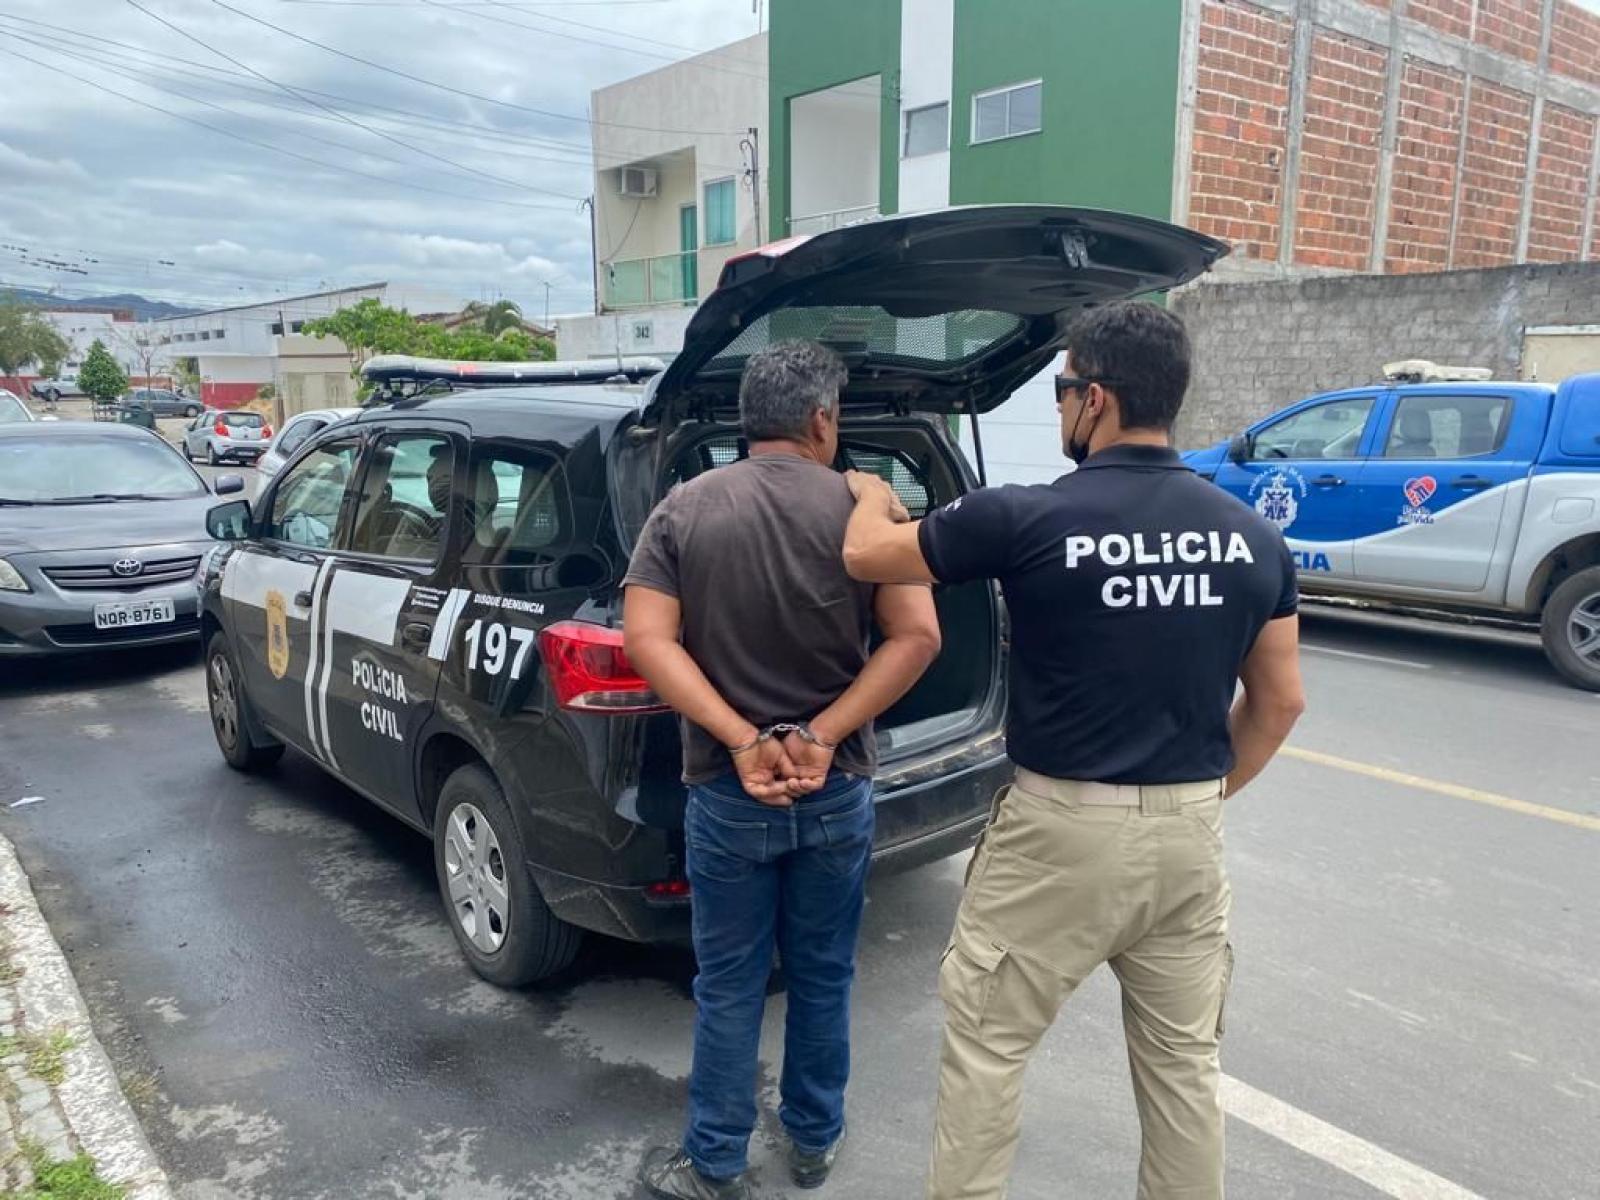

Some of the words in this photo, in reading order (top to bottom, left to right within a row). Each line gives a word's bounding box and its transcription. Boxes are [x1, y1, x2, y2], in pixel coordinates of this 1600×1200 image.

[474, 593, 501, 607] DISQUE
[1101, 574, 1224, 607] CIVIL
[465, 619, 535, 680] 197
[361, 701, 403, 741] CIVIL
